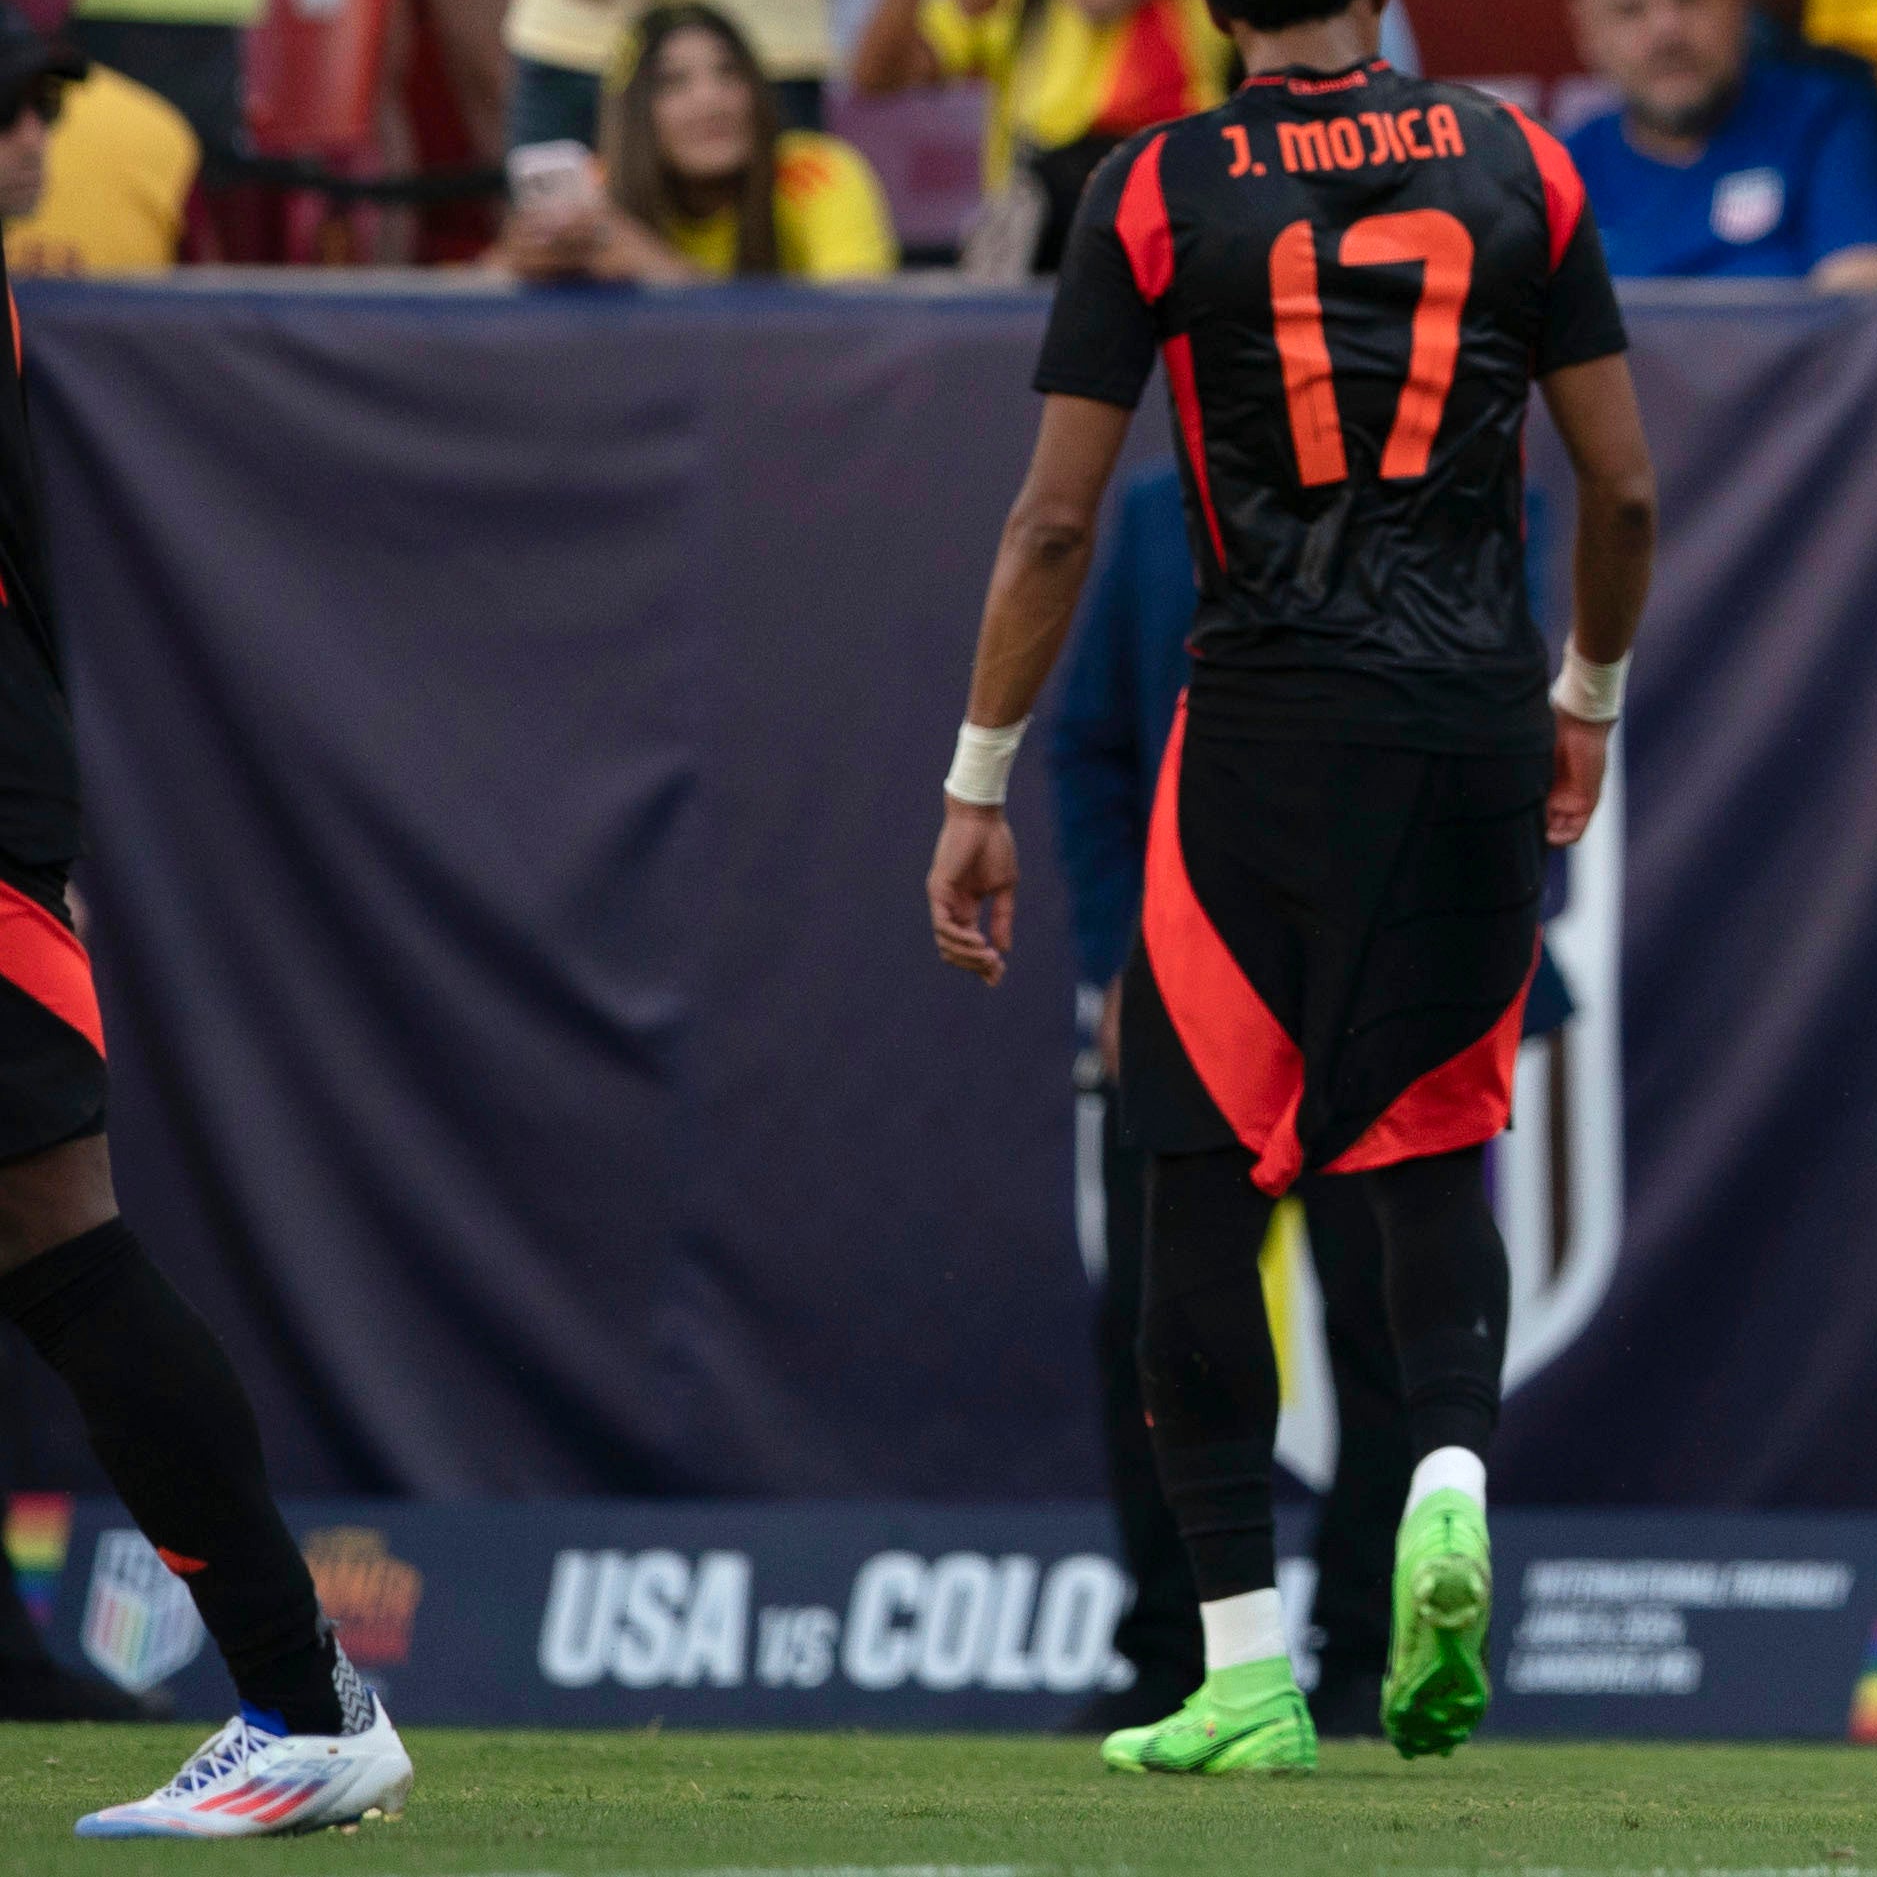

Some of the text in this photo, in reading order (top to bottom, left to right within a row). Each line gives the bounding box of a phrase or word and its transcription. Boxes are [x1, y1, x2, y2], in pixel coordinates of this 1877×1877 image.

[1220, 103, 1466, 179] J. MOJICA
[1268, 207, 1475, 487] 17
[538, 1548, 755, 1690] USA
